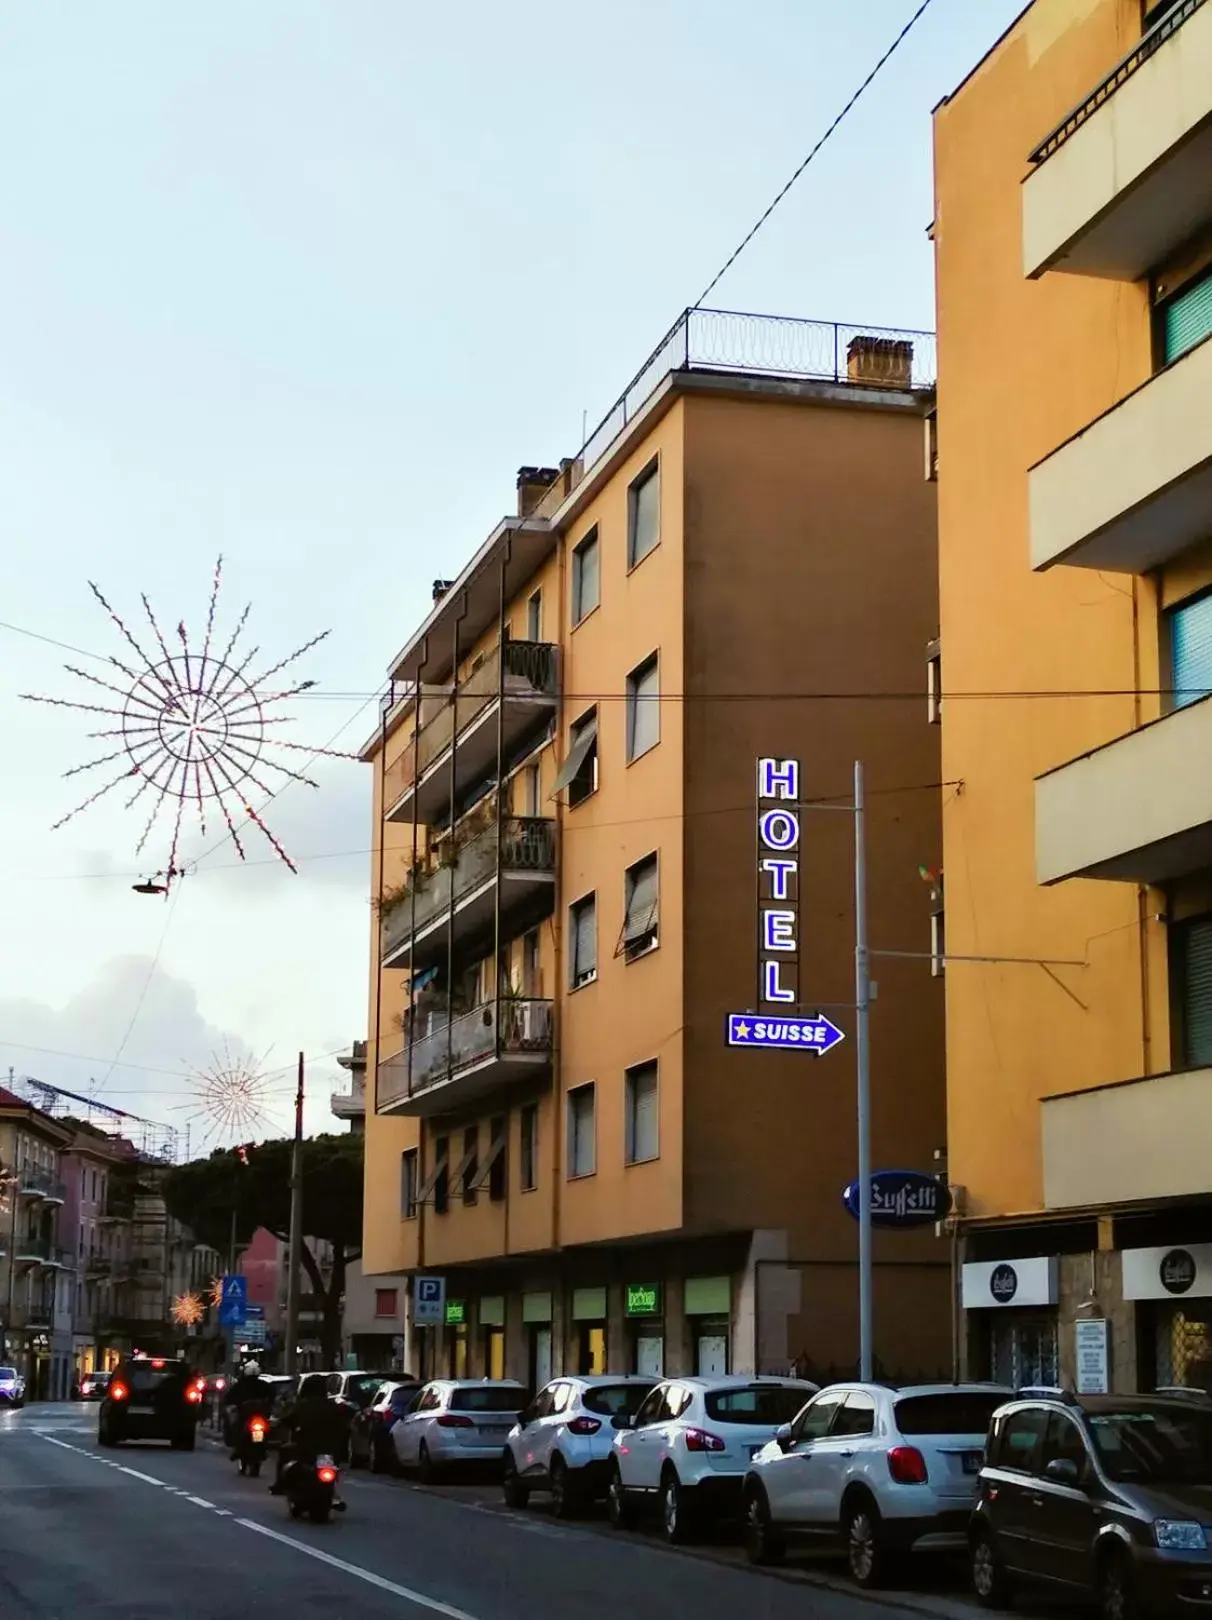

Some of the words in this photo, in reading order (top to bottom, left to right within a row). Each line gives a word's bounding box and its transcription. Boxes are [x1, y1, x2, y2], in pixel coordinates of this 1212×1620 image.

[759, 758, 799, 1003] HOTEL
[753, 1022, 827, 1043] SUISSE
[422, 1282, 437, 1300] P
